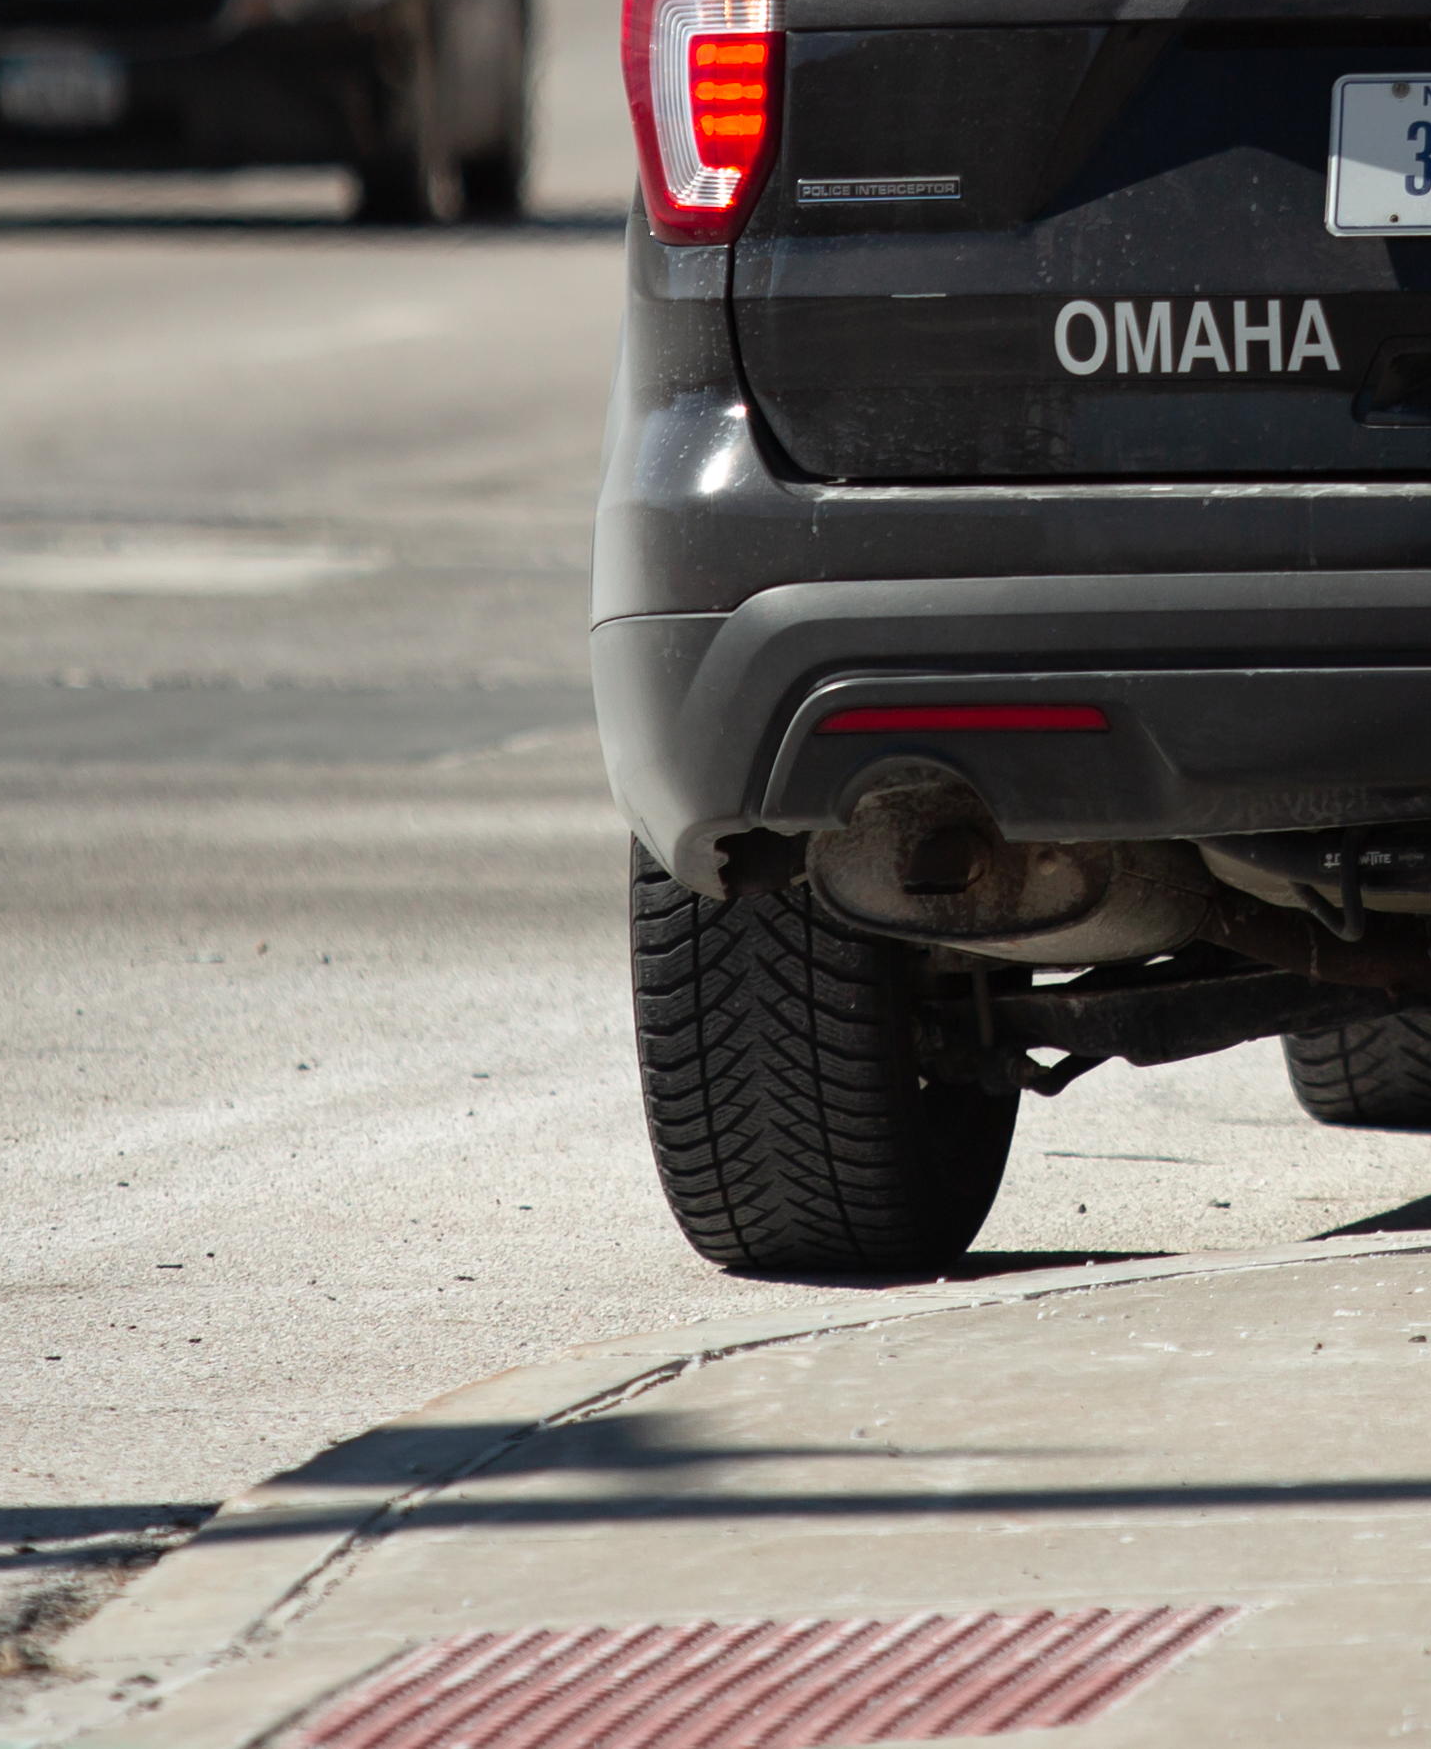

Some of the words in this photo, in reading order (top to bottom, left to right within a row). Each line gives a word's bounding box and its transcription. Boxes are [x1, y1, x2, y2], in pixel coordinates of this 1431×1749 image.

[802, 185, 851, 197] POLICE
[855, 183, 955, 195] INTERCEPTOR
[1054, 299, 1342, 376] OMAHA
